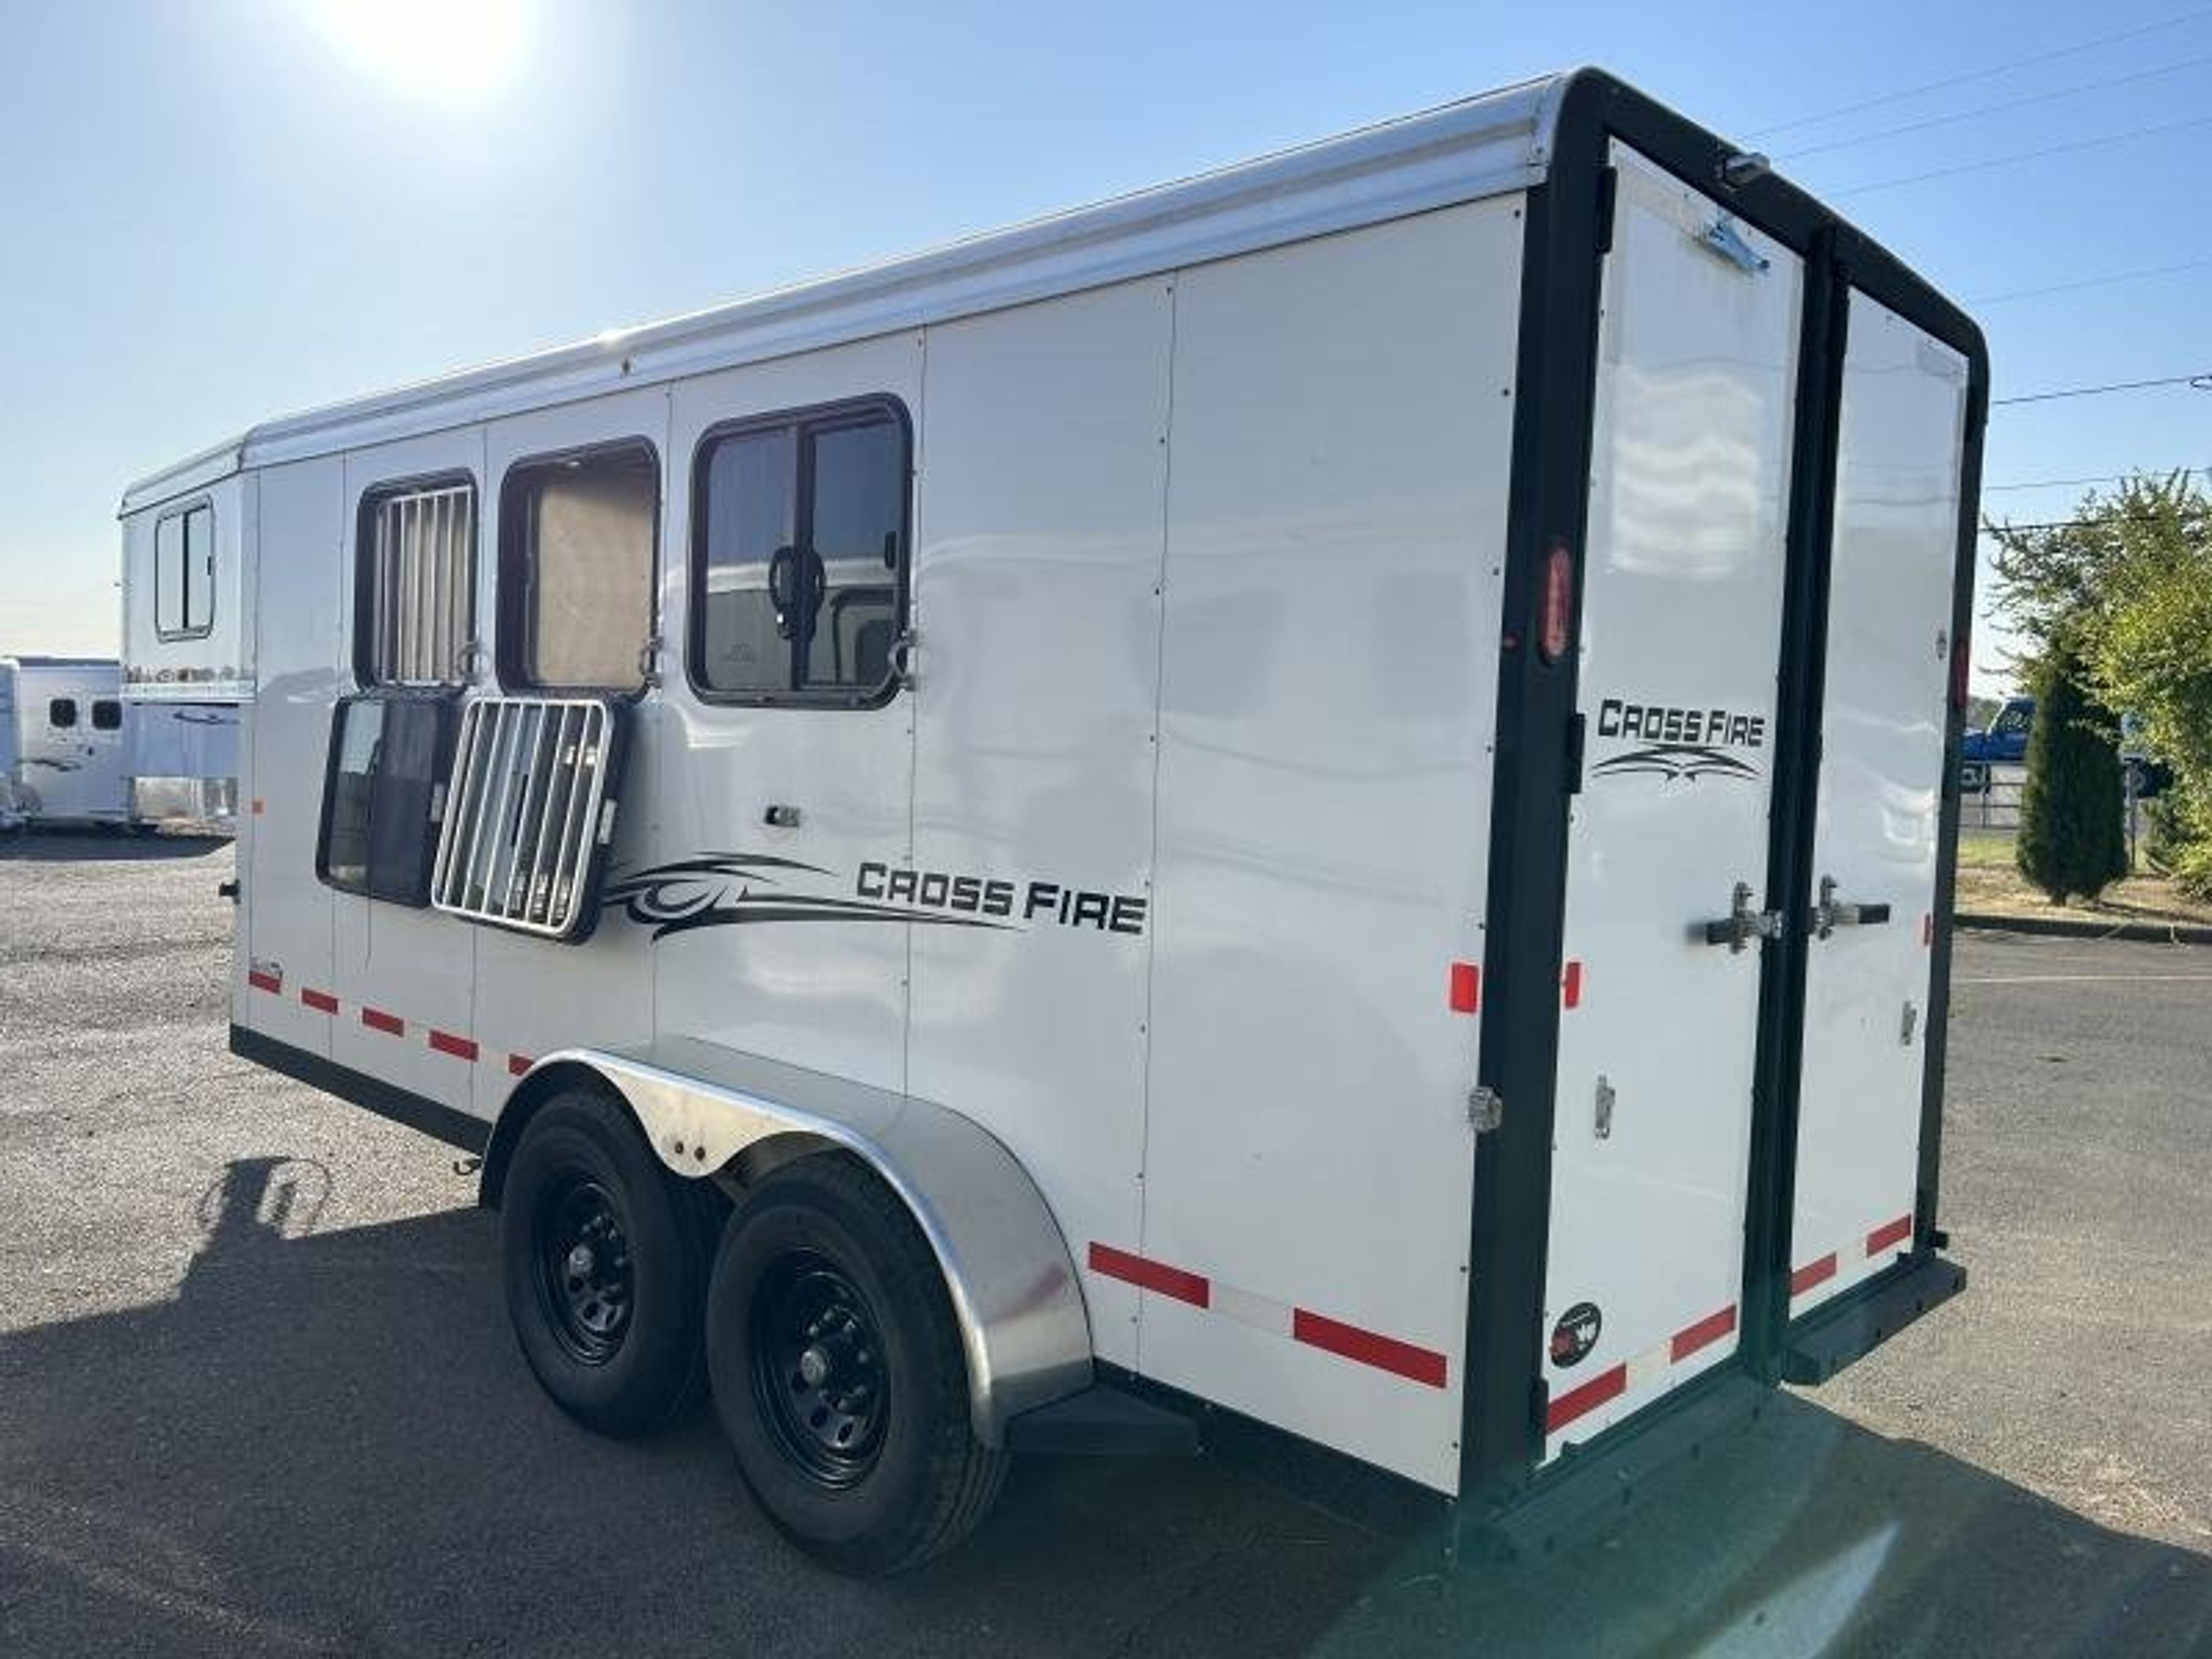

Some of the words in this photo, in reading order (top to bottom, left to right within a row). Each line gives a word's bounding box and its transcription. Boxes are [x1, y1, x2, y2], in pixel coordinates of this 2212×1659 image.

[1598, 699, 1702, 742] CROSS
[1706, 710, 1765, 747] FIRE
[857, 862, 1014, 916] CROSS
[1023, 882, 1147, 935] FIRE
